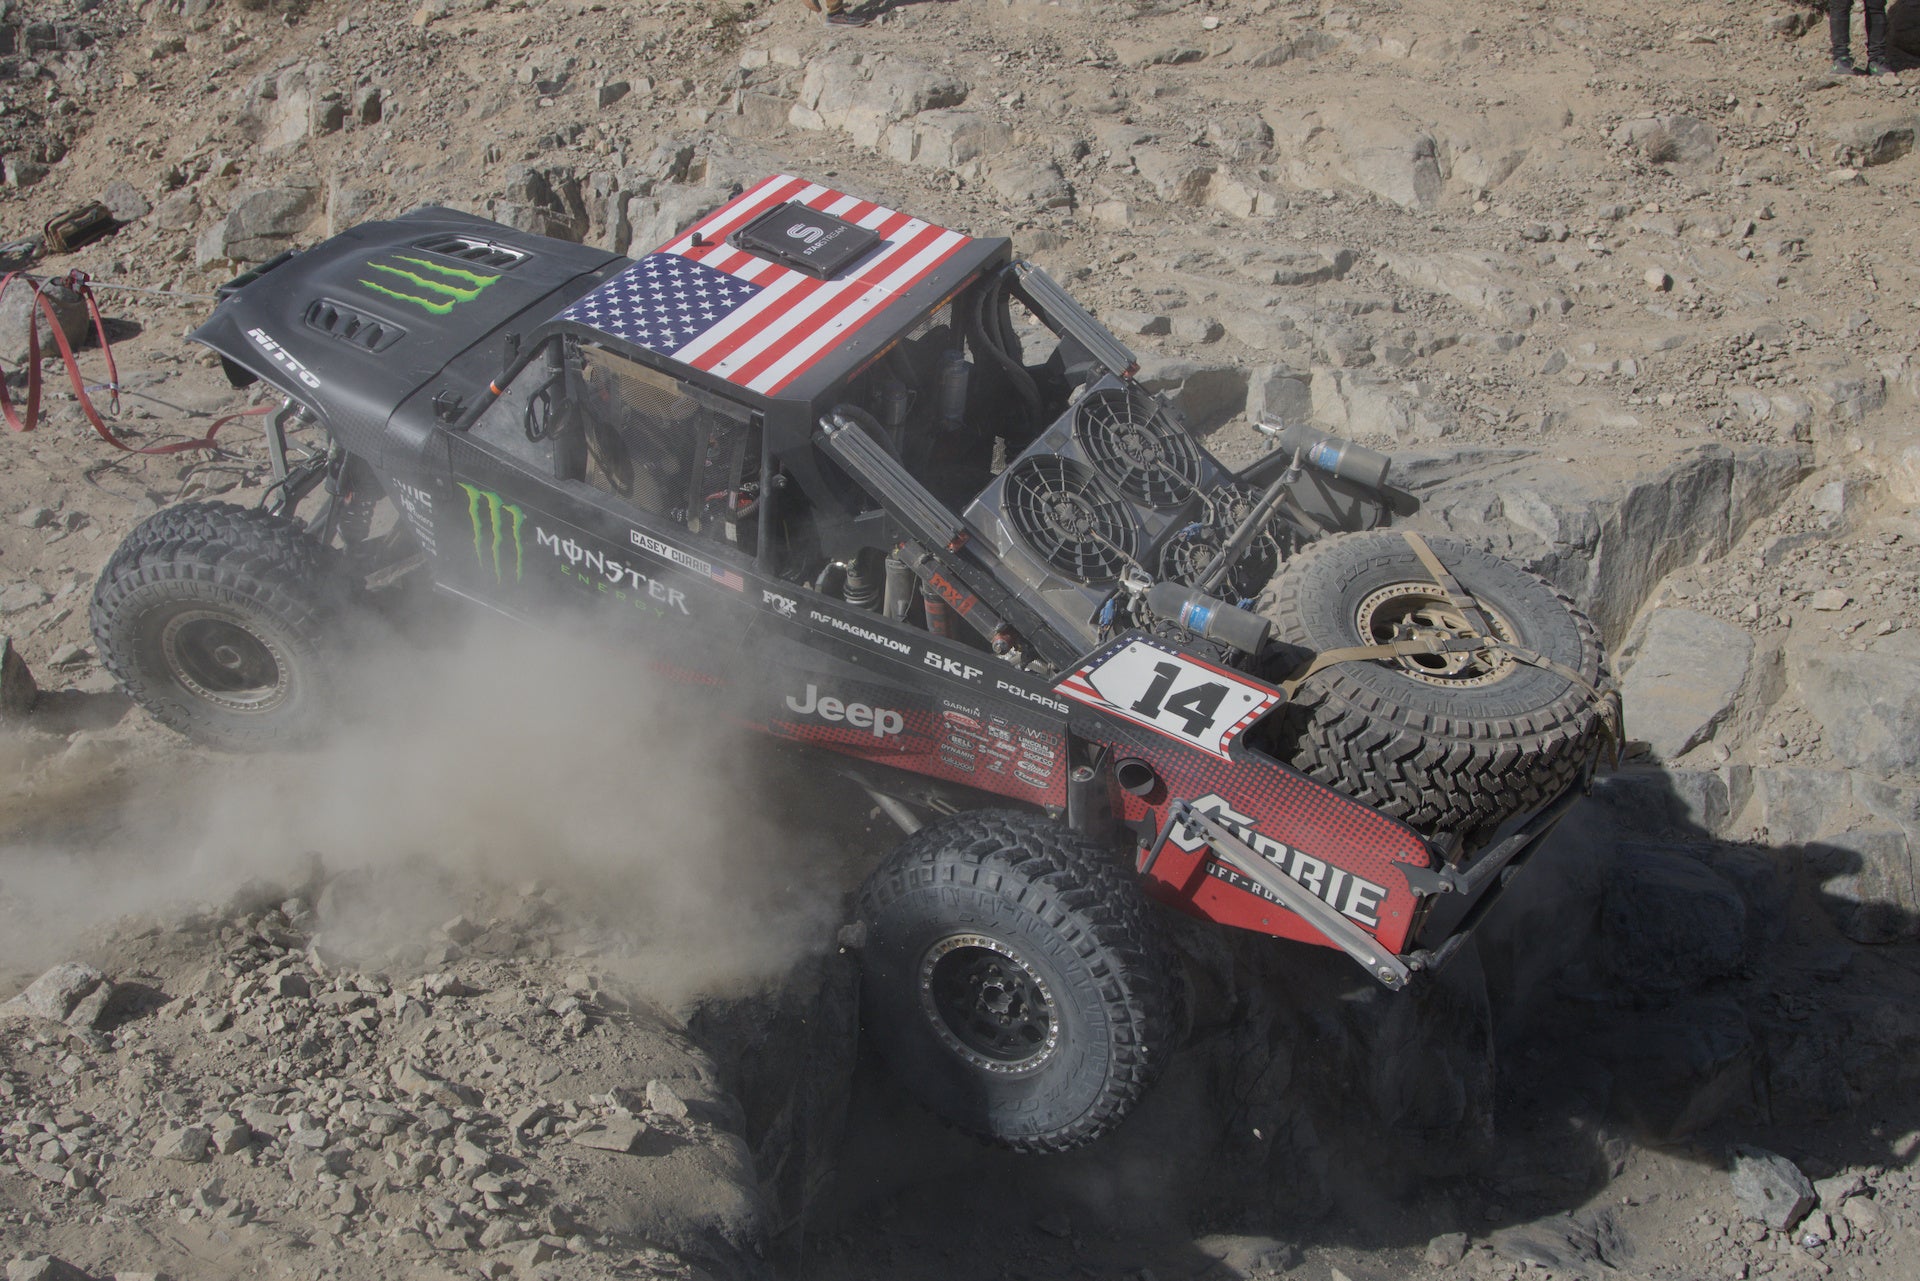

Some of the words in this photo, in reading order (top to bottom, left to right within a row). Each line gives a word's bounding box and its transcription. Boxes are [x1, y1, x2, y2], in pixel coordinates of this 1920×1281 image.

[803, 225, 848, 256] STARSTREAM
[247, 327, 321, 389] NITTO
[535, 526, 690, 614] MONSTER
[632, 532, 667, 556] CASEY
[671, 549, 711, 575] CURRIE
[561, 564, 664, 617] ENERGY
[762, 590, 798, 618] FOX
[929, 573, 963, 607] FOX
[831, 617, 911, 654] MAGNAFLOW
[924, 650, 983, 680] SKF
[786, 683, 904, 738] Jeep
[943, 699, 980, 717] GARMIN
[996, 679, 1069, 714] POLARIS
[1130, 661, 1230, 738] 14
[941, 743, 975, 760] DYNAMIC
